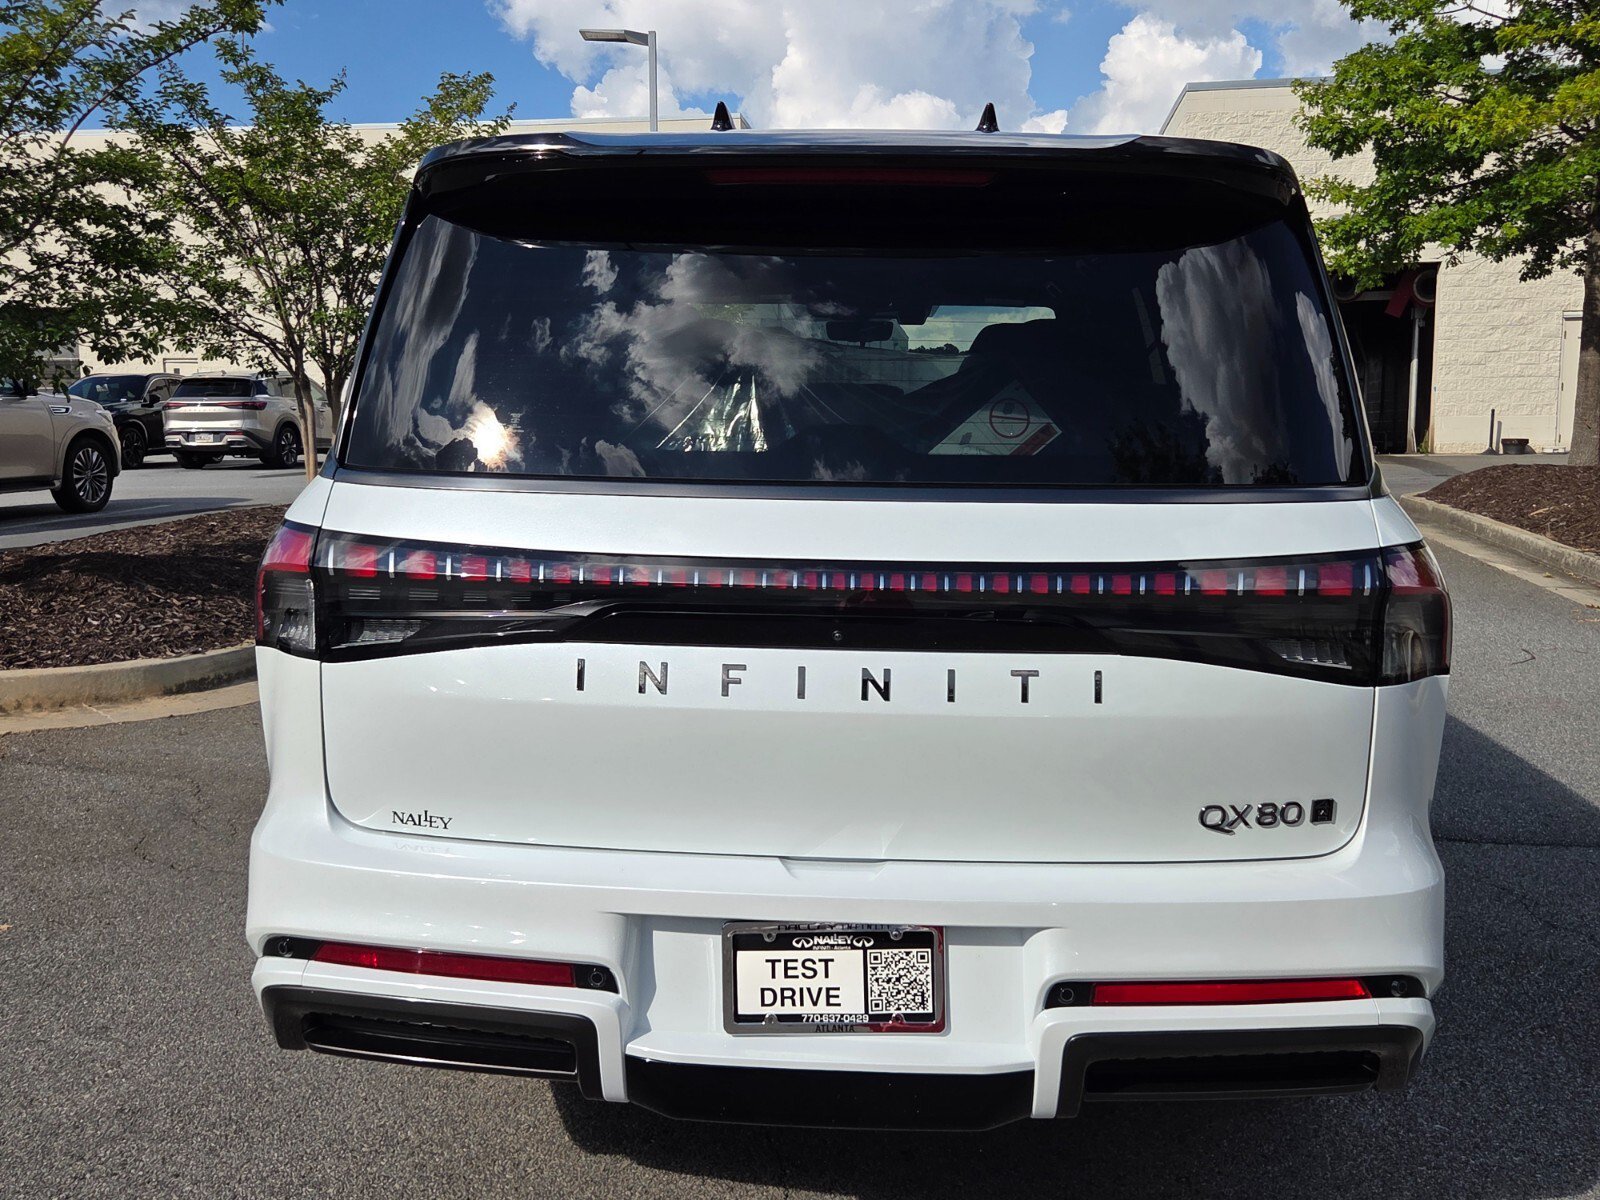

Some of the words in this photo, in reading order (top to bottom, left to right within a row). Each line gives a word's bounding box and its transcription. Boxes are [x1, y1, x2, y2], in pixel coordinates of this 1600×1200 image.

[576, 658, 1102, 704] INFINITI
[392, 810, 453, 829] NALLEY
[1198, 801, 1305, 835] QX80
[813, 933, 854, 945] NALLEY
[765, 958, 834, 979] TEST
[760, 987, 841, 1008] DRIVE
[802, 1014, 869, 1023] 770-637-0429
[815, 1024, 855, 1033] ATLANTA
